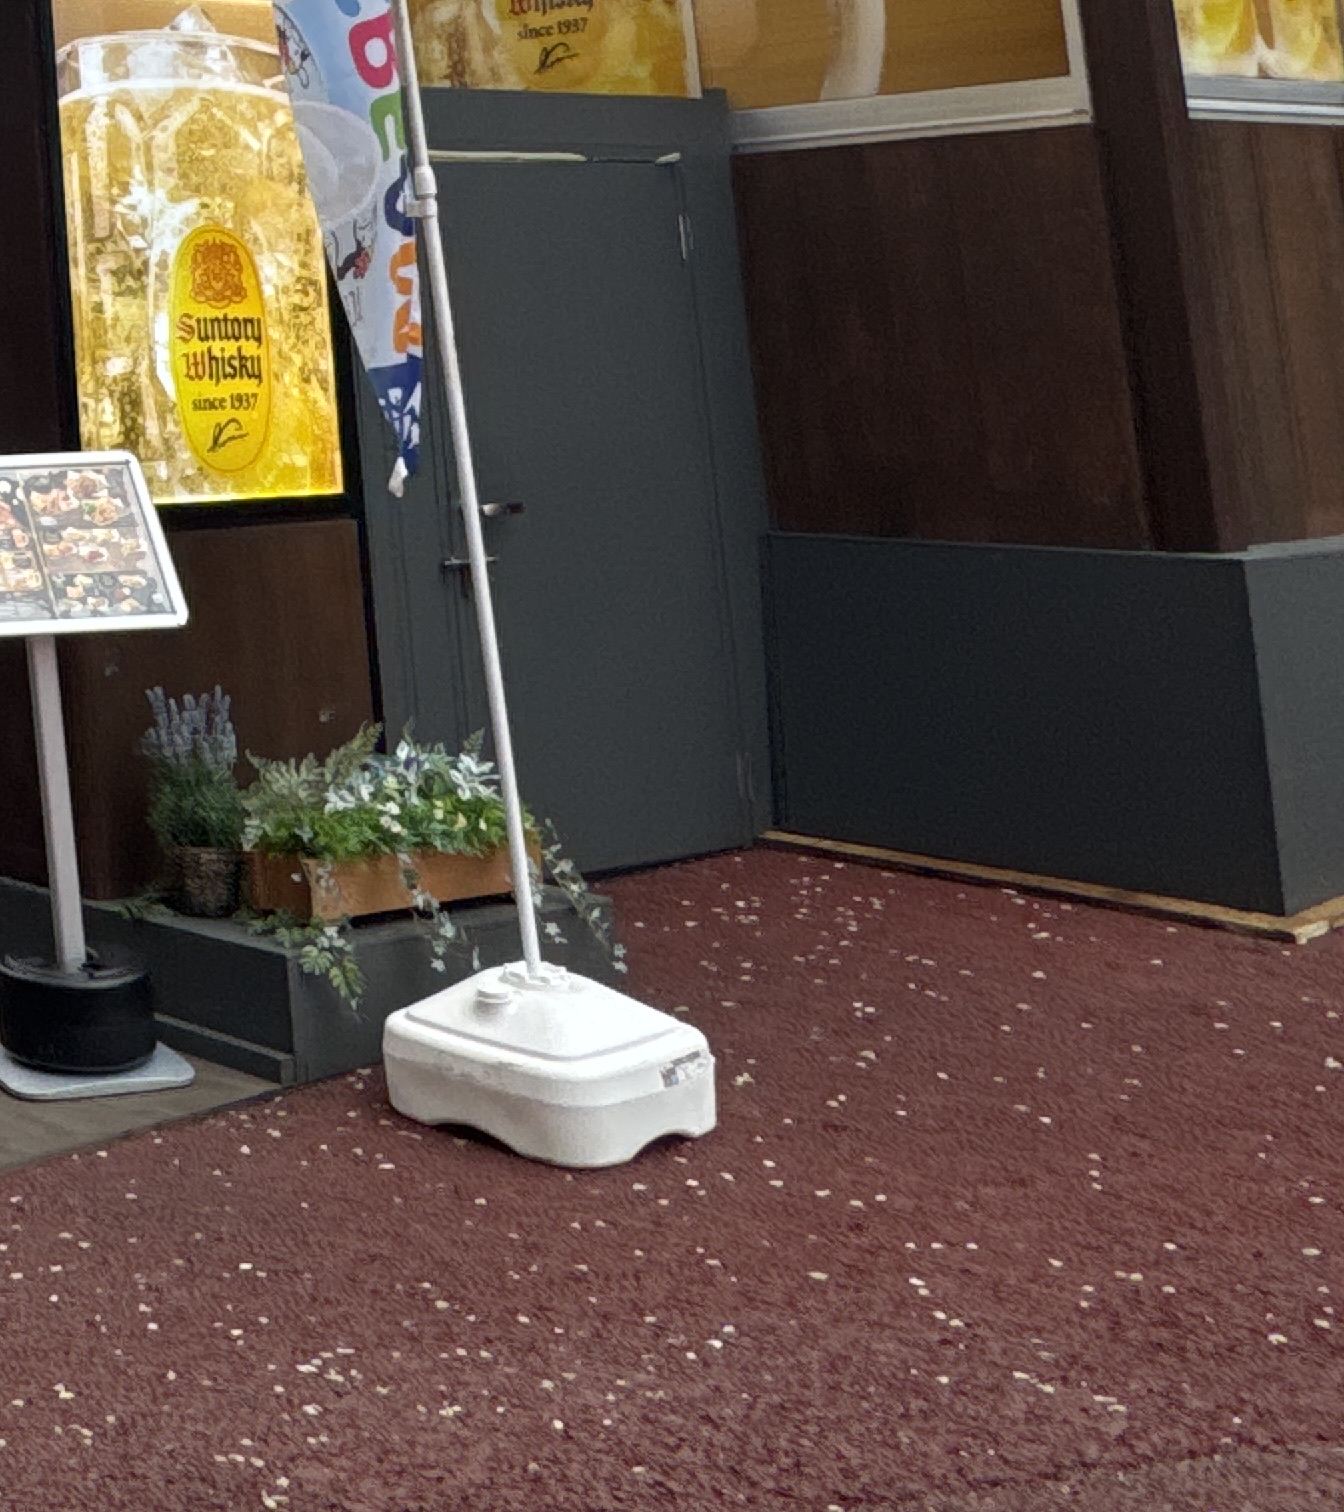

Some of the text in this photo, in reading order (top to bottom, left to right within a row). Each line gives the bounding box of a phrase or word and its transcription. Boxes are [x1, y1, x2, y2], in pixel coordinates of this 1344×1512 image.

[516, 16, 588, 40] since 1937
[176, 312, 264, 350] Suntory
[180, 344, 264, 388] Whisky
[192, 392, 260, 411] since 1937
